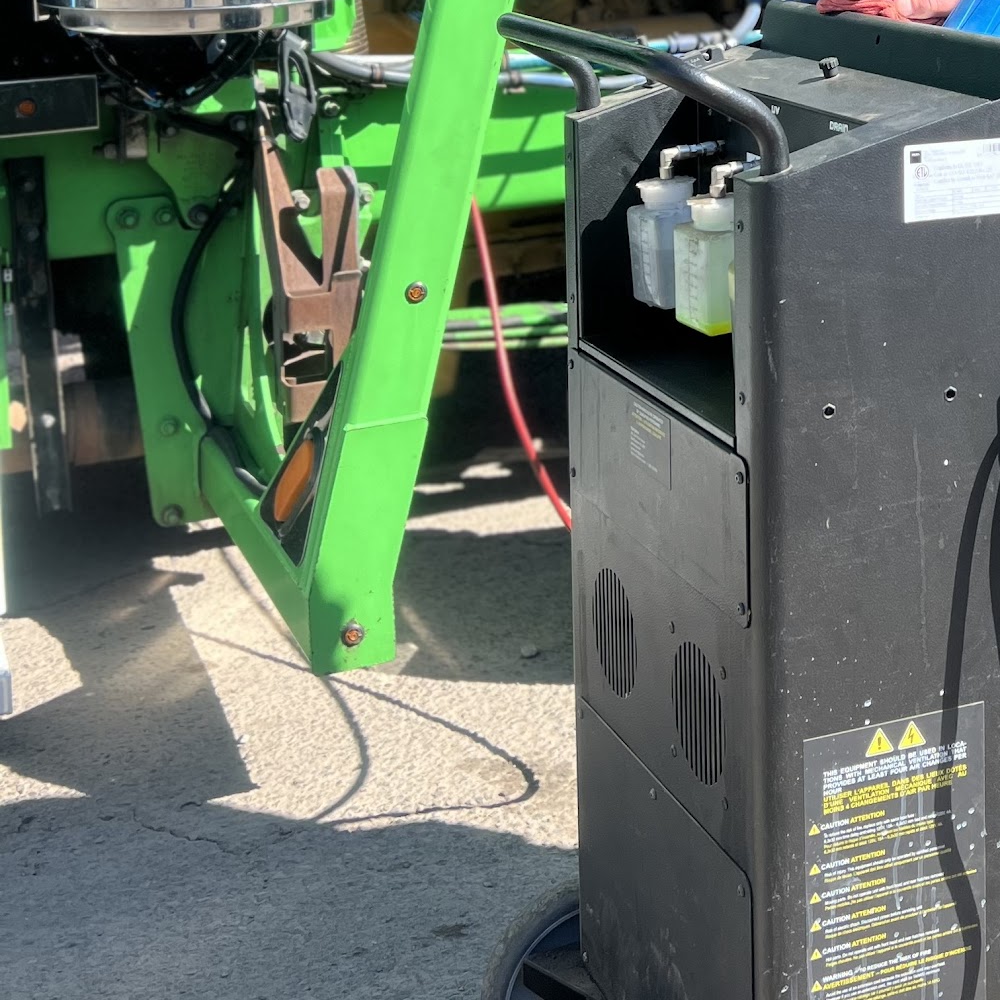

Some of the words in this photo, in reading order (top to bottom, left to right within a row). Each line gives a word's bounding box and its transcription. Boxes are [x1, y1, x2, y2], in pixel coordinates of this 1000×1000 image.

[771, 105, 781, 115] UV
[829, 120, 849, 133] DRAIN
[823, 769, 837, 778] THIS
[840, 760, 877, 774] EQUIPMENT
[879, 753, 905, 765] SHOULD
[908, 750, 916, 758] BE
[919, 746, 936, 756] USED
[823, 774, 842, 783] TIONS
[845, 769, 861, 778] WITH
[864, 759, 905, 774] MECHANICAL
[908, 749, 948, 764] VENTILATION
[951, 745, 966, 754] THAT
[823, 777, 855, 790] PROVIDES
[857, 774, 865, 782] AT
[867, 769, 887, 780] LEAST
[909, 762, 920, 770] AIR
[923, 755, 951, 767] CHANGES
[954, 751, 966, 760] PER
[823, 790, 852, 802] UTILISER
[891, 777, 909, 786] DANS
[911, 773, 924, 782] DES
[926, 769, 943, 779] LIEUX
[823, 786, 842, 796] HOUR
[848, 787, 889, 802] VENTILATION
[936, 773, 953, 782] AVEC
[823, 804, 844, 815] MOINS
[845, 802, 849, 810] 4
[850, 791, 898, 809] CHANGEMENTS
[899, 787, 916, 797] D'AIR
[917, 784, 930, 793] PAR
[931, 779, 952, 790] HEURE
[820, 818, 849, 831] CAUTION
[850, 810, 885, 825] ATTENTION
[821, 857, 849, 870] CAUTION
[850, 848, 885, 863] ATTENTION
[821, 885, 850, 898] CAUTION
[850, 876, 885, 891] ATTENTION
[821, 913, 850, 926] CAUTION
[851, 904, 886, 918] ATTENTION
[822, 941, 850, 954] CAUTION
[851, 932, 886, 947] ATTENTION
[912, 953, 919, 961] OF
[823, 972, 874, 991] AVERTISSEMENT
